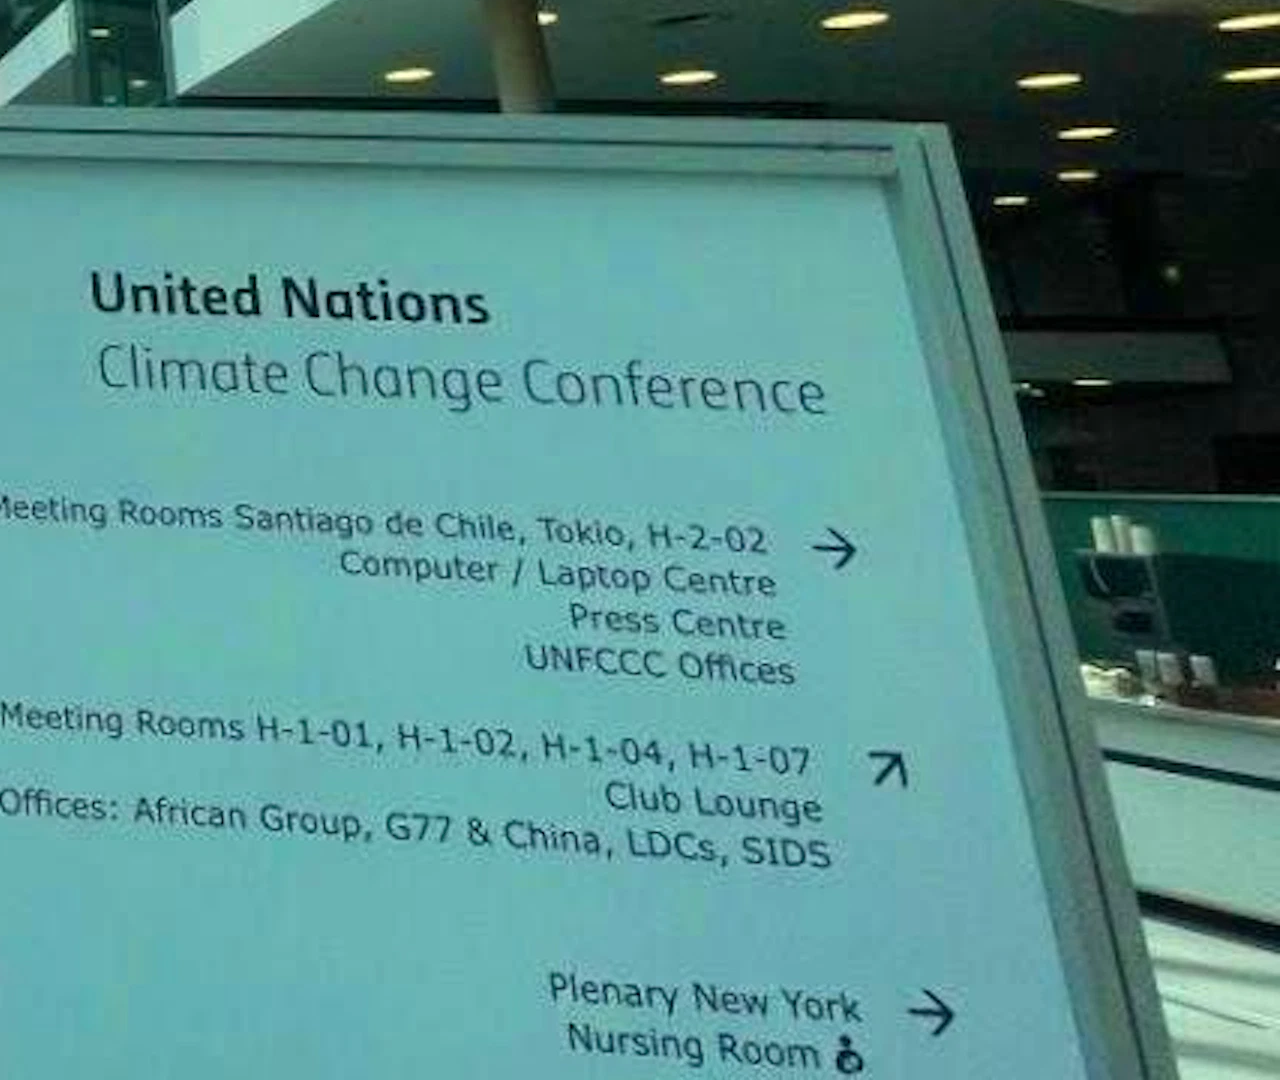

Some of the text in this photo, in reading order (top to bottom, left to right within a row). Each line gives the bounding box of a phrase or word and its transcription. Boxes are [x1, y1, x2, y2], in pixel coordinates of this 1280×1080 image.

[90, 270, 492, 325] United Nations
[98, 343, 826, 415] Climate Change Conference
[118, 498, 224, 529] Rooms
[234, 503, 374, 540] Santiago
[385, 511, 424, 538] de
[434, 511, 526, 547] Chile,
[535, 516, 635, 553] Tokio,
[647, 523, 768, 555] H-2-02
[339, 549, 777, 598] Computer / Laptop Centre
[569, 602, 787, 641] Press Centre
[524, 644, 796, 686] UNFCCC Offices
[0, 700, 810, 776] Meeting Rooms H-1-01, H-1-02, H-1-04, H-1-07
[604, 780, 823, 829] Club Lounge
[133, 795, 247, 830] African
[259, 803, 373, 843] Group,
[385, 811, 452, 844] G77
[467, 816, 493, 847] &
[503, 819, 613, 861] China,
[626, 828, 728, 869] LDCs,
[742, 835, 833, 870] SIDS
[548, 971, 863, 1023] Plenary New York
[567, 1021, 821, 1069] Nursing Room
